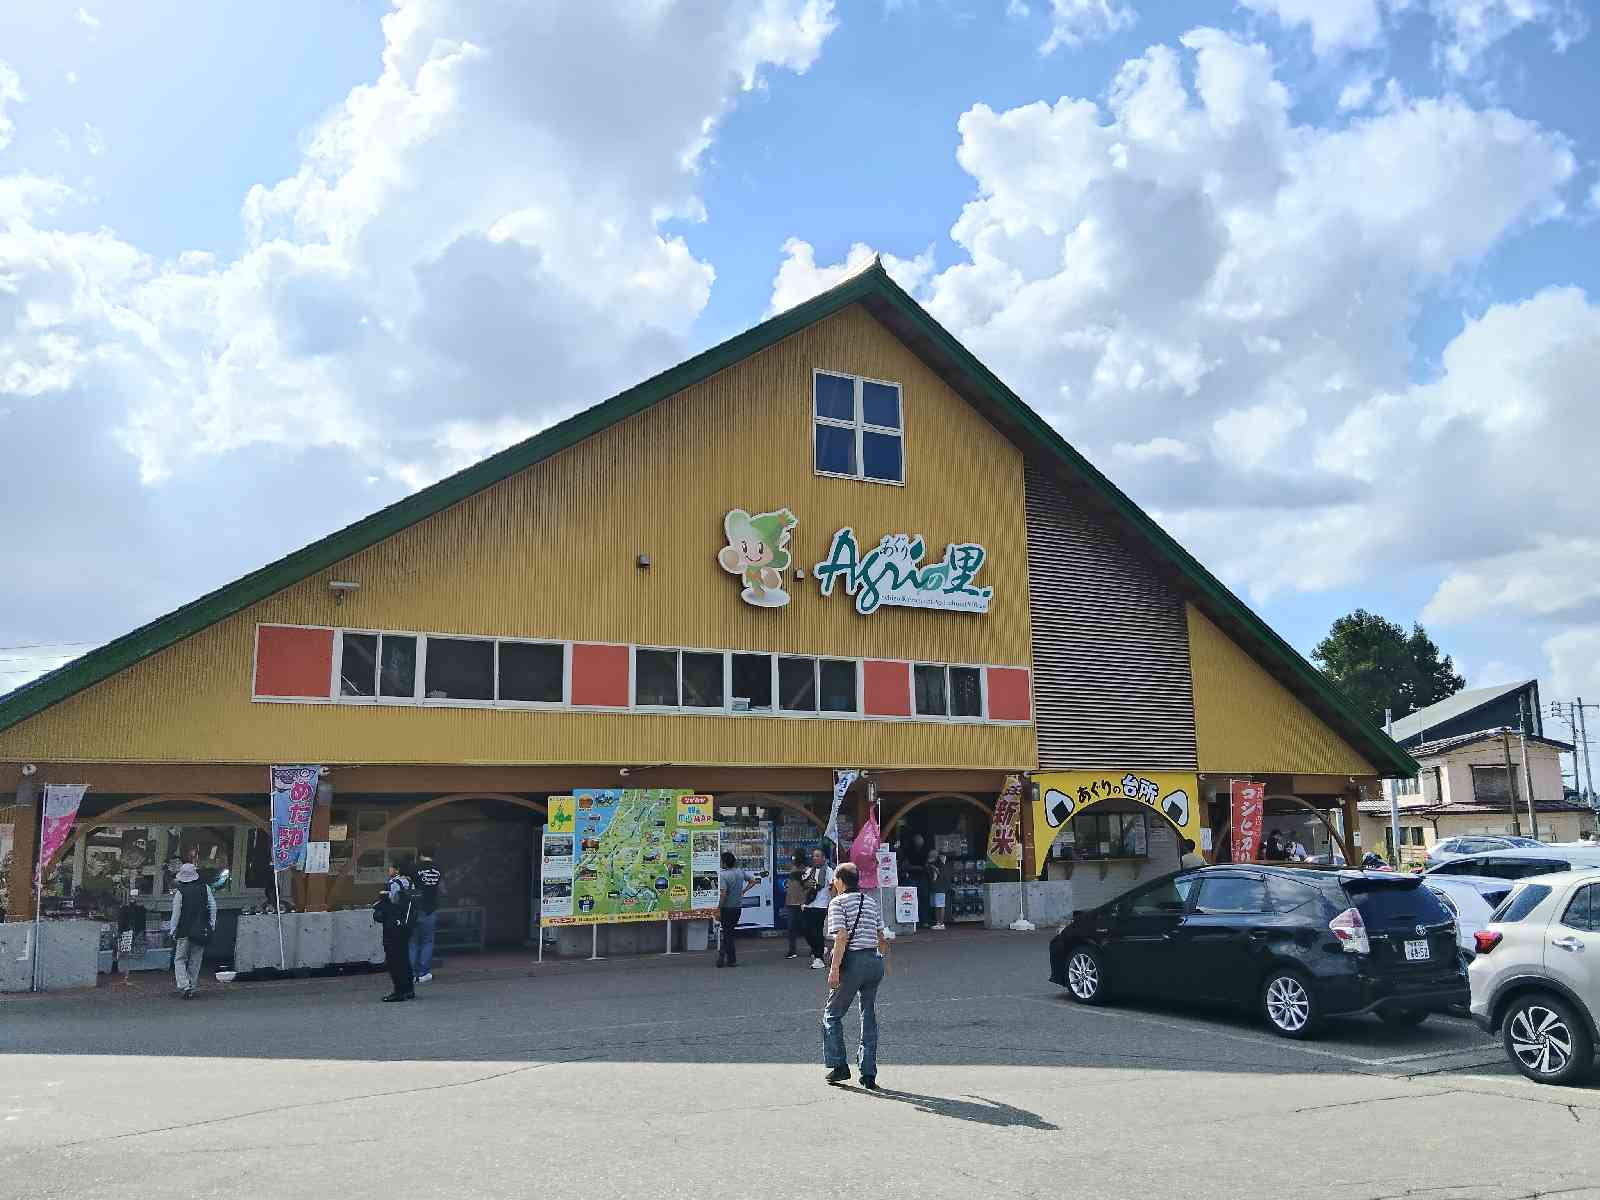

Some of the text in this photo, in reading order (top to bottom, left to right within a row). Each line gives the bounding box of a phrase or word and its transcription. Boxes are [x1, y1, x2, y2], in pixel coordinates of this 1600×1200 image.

[879, 537, 912, 560] あぐり
[1076, 773, 1160, 805] あぐりの台所
[991, 800, 1019, 855] 新米
